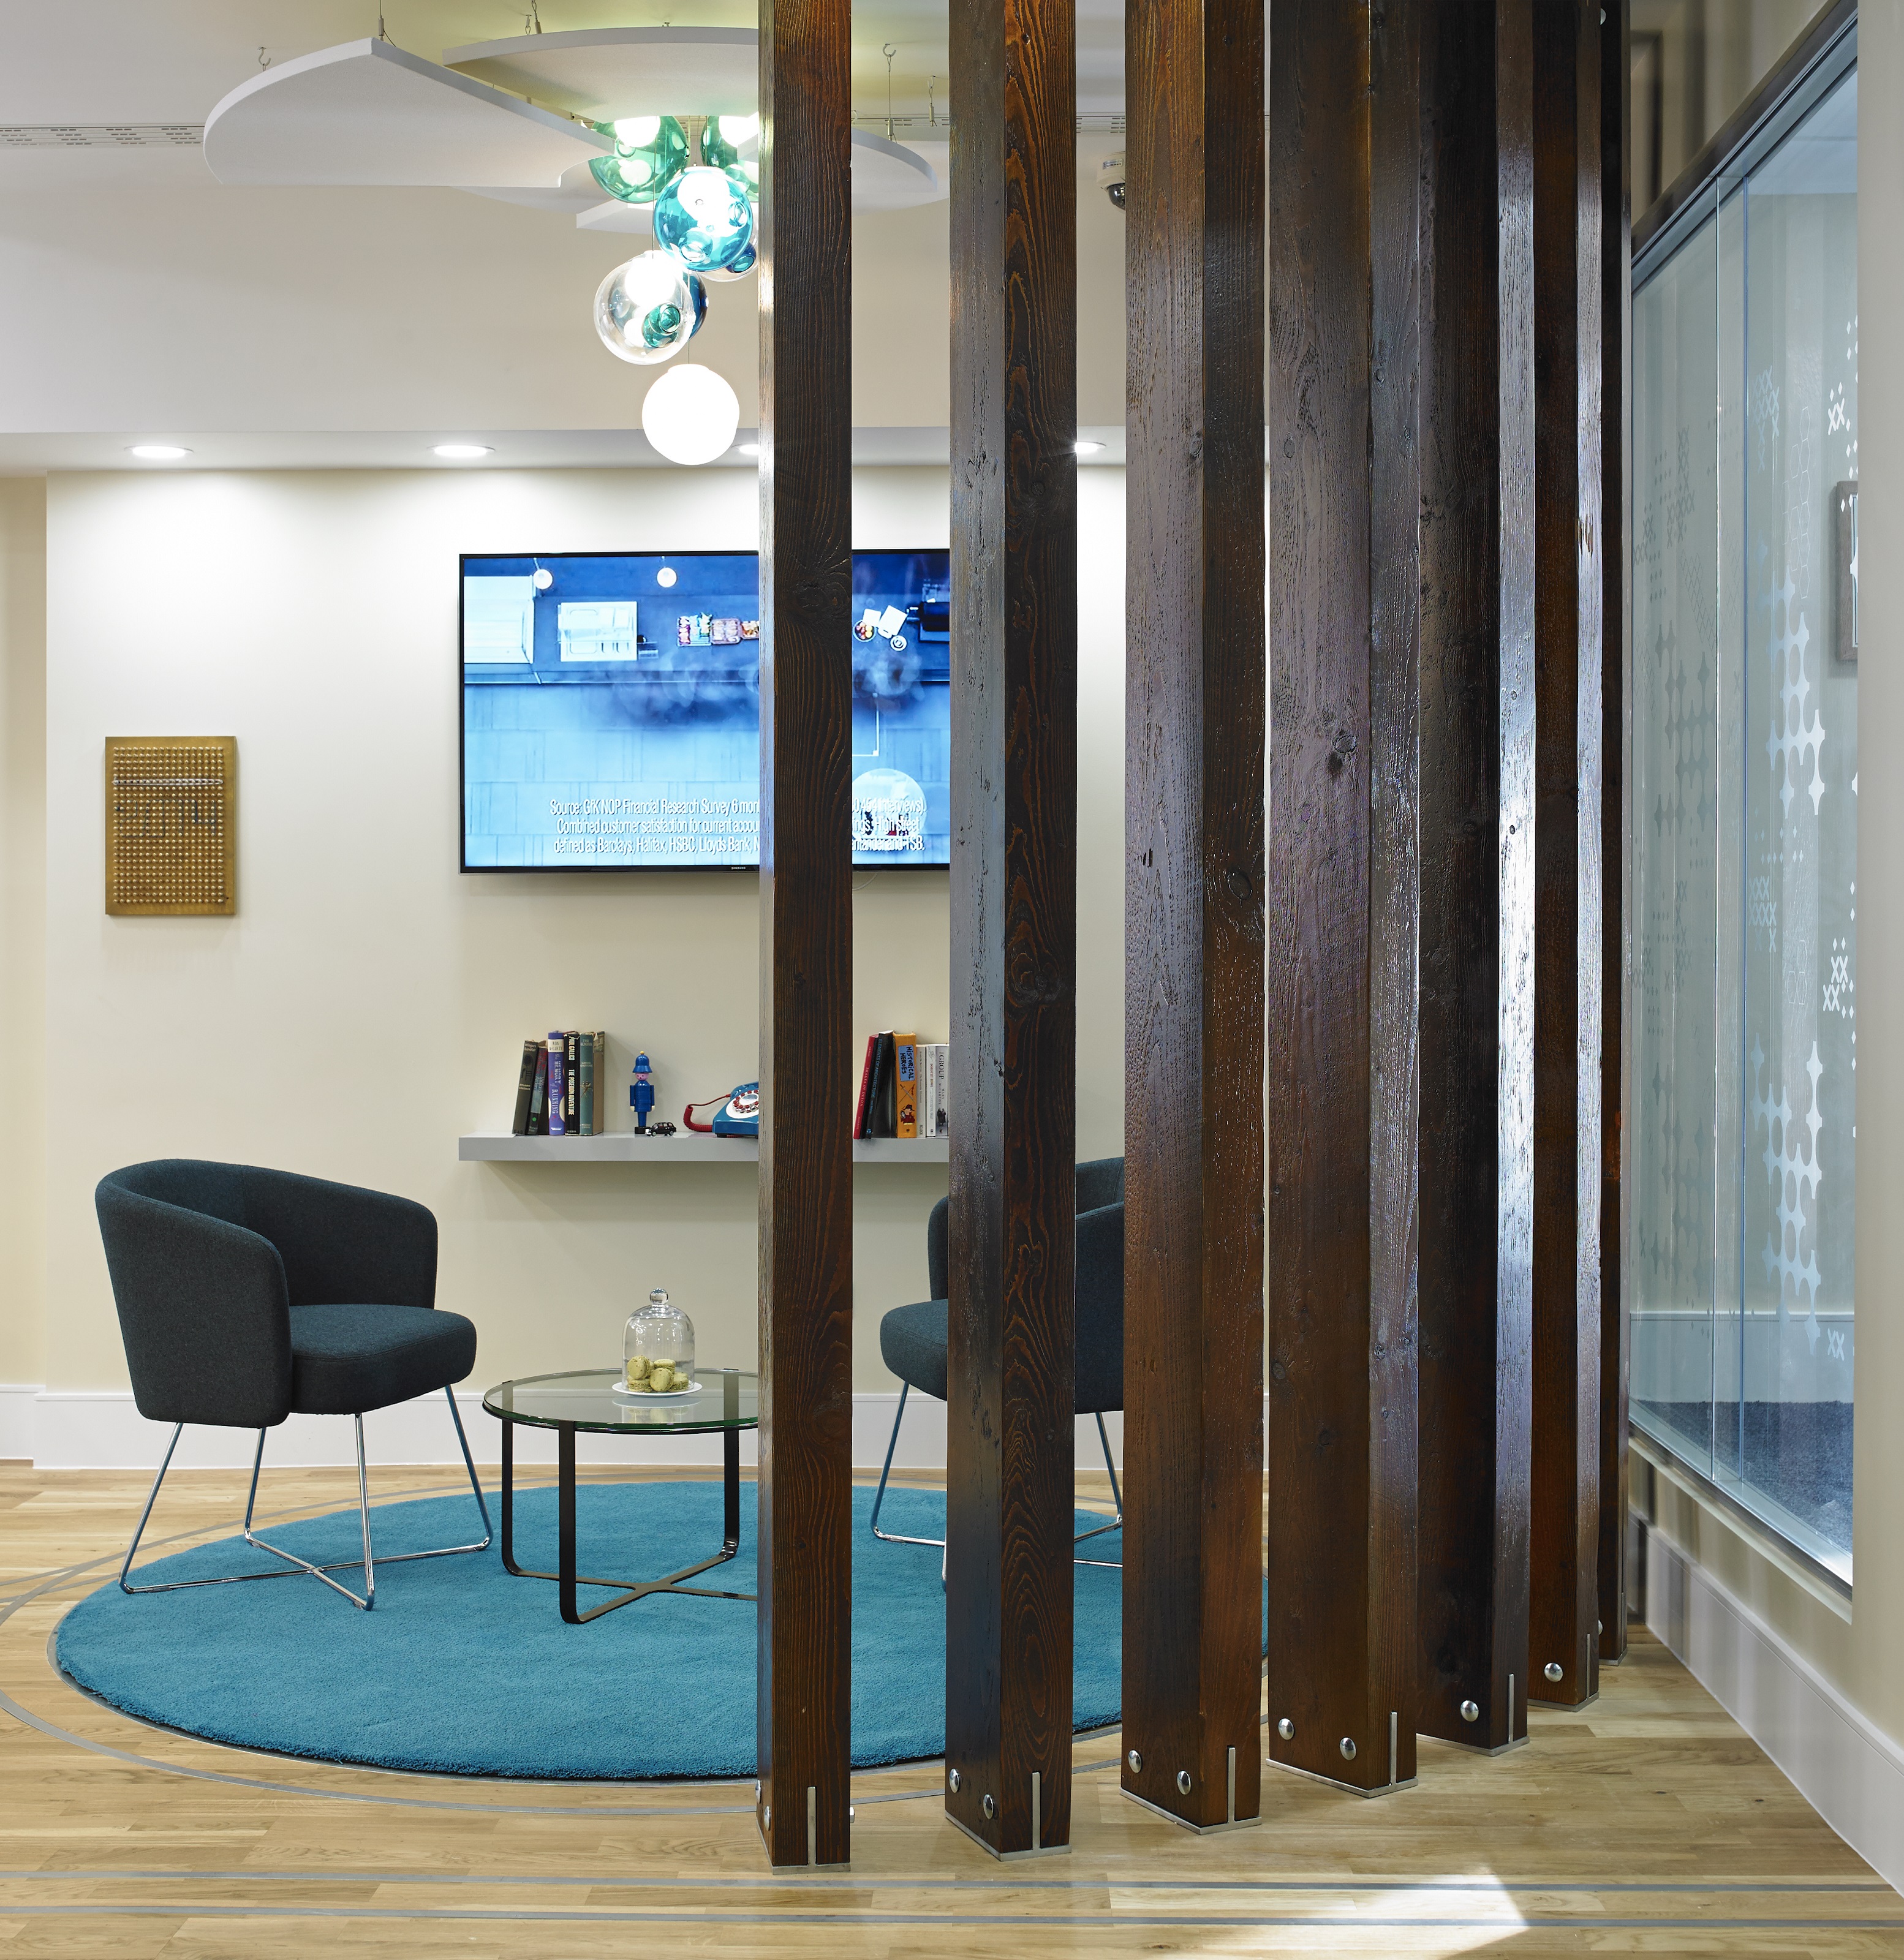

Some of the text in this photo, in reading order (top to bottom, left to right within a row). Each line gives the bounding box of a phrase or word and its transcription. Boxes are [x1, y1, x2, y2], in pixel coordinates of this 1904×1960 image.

[550, 799, 582, 815] Source:
[601, 799, 622, 815] NOP
[622, 799, 660, 815] Financial
[662, 799, 700, 815] Research
[701, 798, 731, 817] Survey
[731, 798, 739, 814] 6
[852, 797, 877, 815] 0,454
[557, 818, 601, 834] Combined
[601, 819, 641, 834] customer
[641, 818, 689, 834] satisfaction
[689, 818, 701, 833] for
[702, 818, 732, 833] current
[733, 820, 760, 833] accou
[852, 818, 873, 835] ings.
[874, 816, 896, 835] High
[554, 837, 586, 853] defined
[586, 840, 597, 853] as
[597, 837, 635, 856] Barclays,
[636, 837, 668, 854] Halifax,
[670, 836, 698, 854] HSBC,
[699, 837, 727, 855] Lloyds
[728, 837, 752, 854] Bank,
